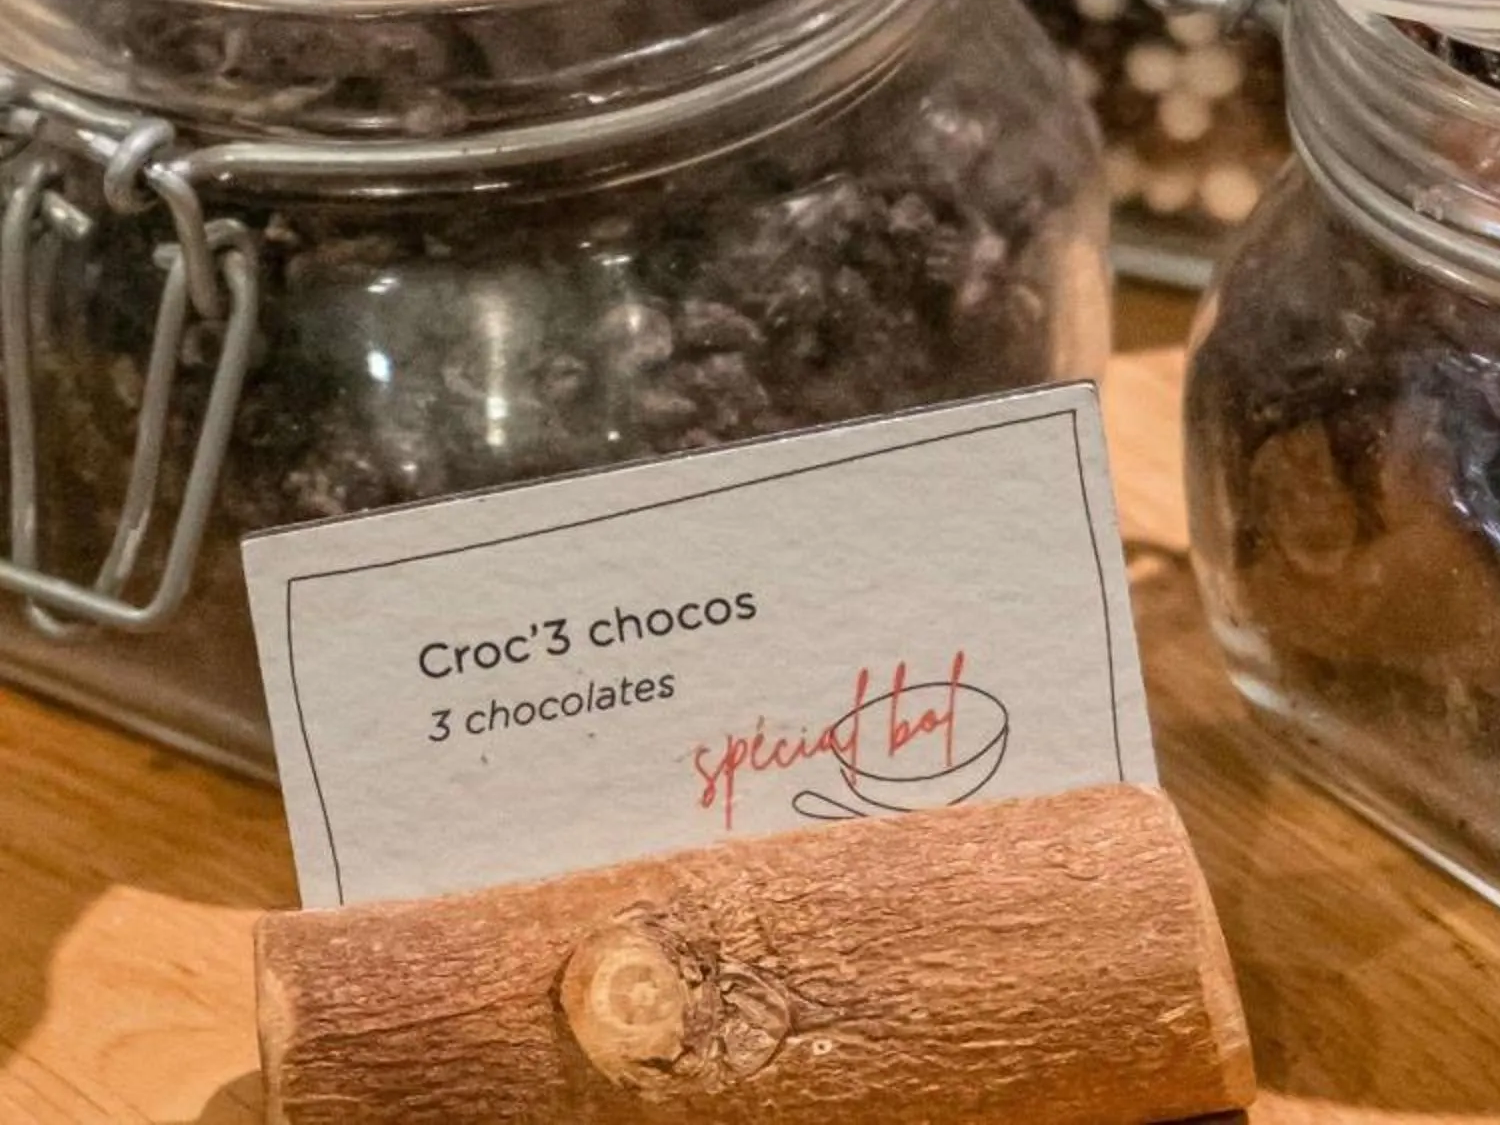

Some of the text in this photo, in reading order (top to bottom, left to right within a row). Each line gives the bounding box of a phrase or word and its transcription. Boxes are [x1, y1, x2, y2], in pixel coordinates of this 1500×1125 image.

[418, 591, 758, 679] Croc'3 chocos
[427, 674, 676, 743] 3 chocolates
[888, 650, 965, 767] bol
